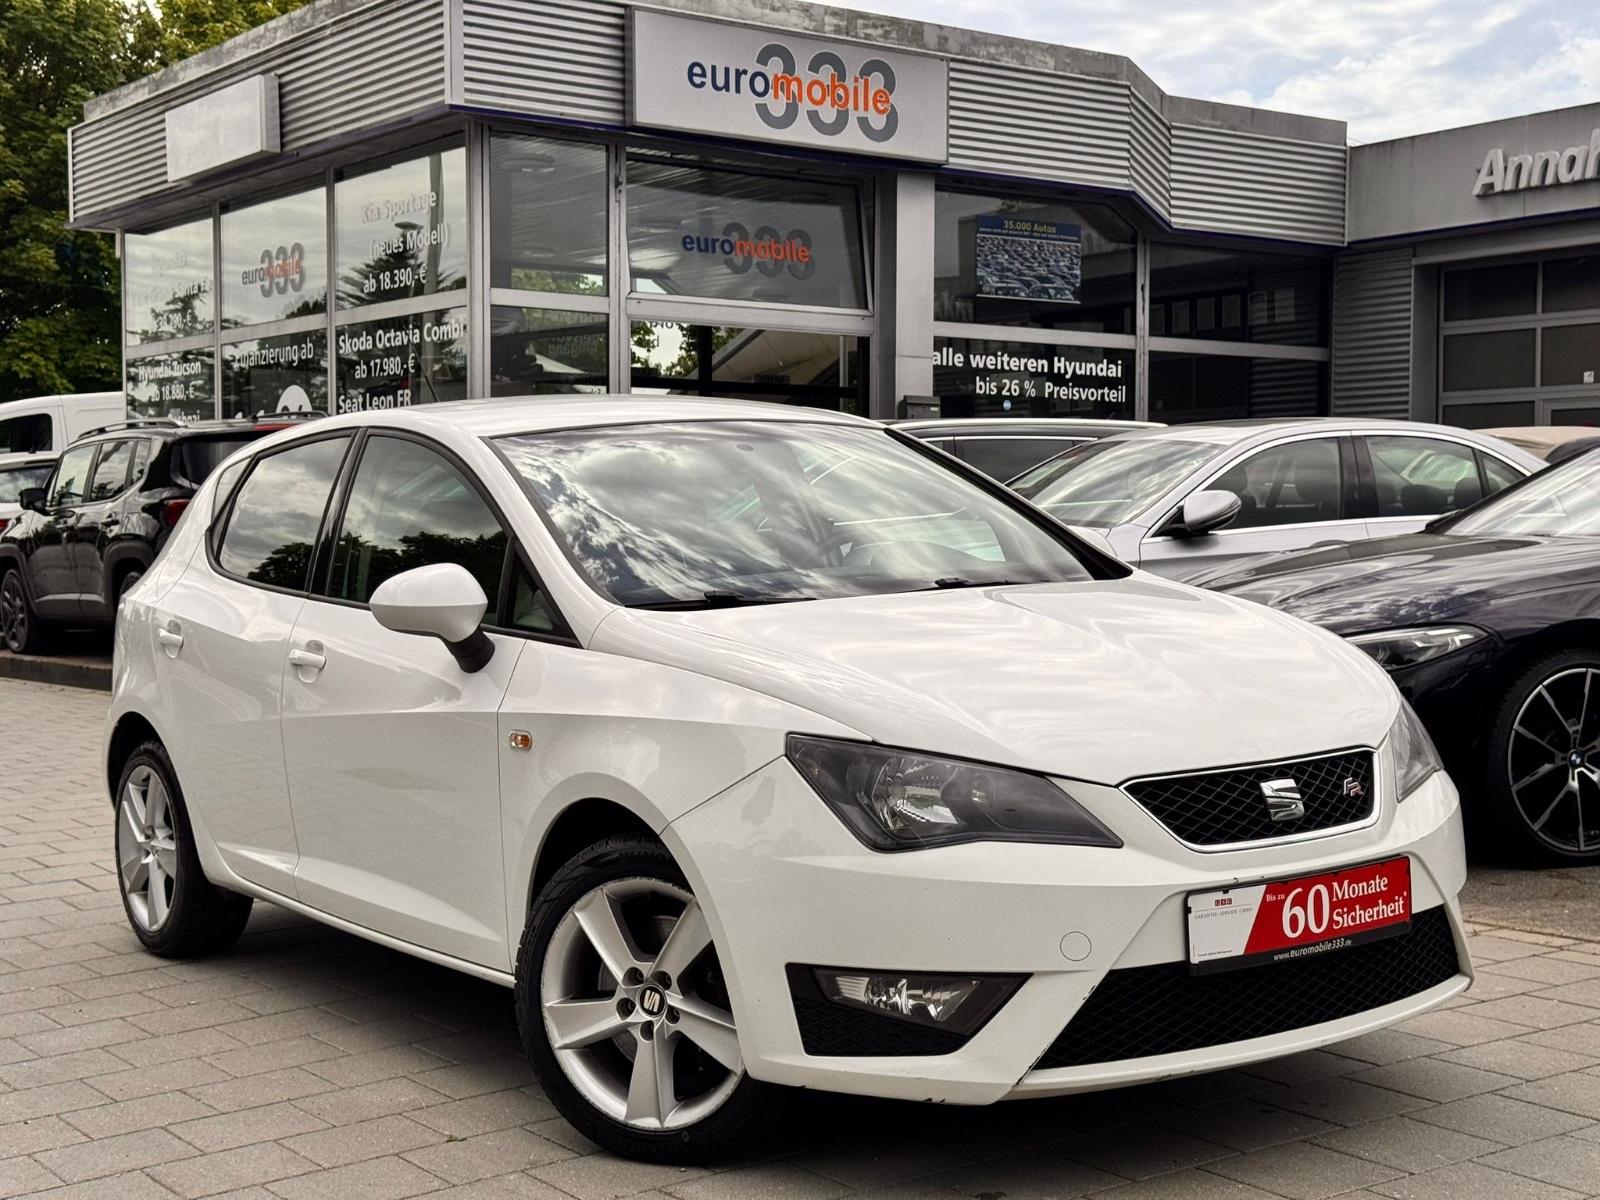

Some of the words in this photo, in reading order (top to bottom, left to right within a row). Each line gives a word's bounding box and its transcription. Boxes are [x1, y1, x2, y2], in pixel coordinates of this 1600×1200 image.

[686, 61, 891, 115] euromobile
[1003, 220, 1032, 231] 35.000
[1033, 223, 1057, 234] Autos
[681, 233, 811, 263] euromobile
[363, 273, 377, 293] ab
[301, 337, 314, 360] ab
[339, 330, 372, 354] Skoda
[376, 324, 420, 348] Octavia
[138, 361, 171, 384] Hyundai
[354, 360, 368, 379] ab
[932, 348, 964, 367] alle
[970, 351, 1048, 373] weiteren
[1053, 357, 1122, 379] Hyundai
[976, 377, 997, 395] bis
[1001, 379, 1020, 396] 26
[1024, 380, 1036, 397] %
[1045, 382, 1126, 403] Preisvorteil
[339, 393, 363, 413] Seat
[366, 392, 393, 411] Leon
[1265, 893, 1277, 902] Bis
[1332, 874, 1388, 902] Monate
[1282, 884, 1330, 938] 60
